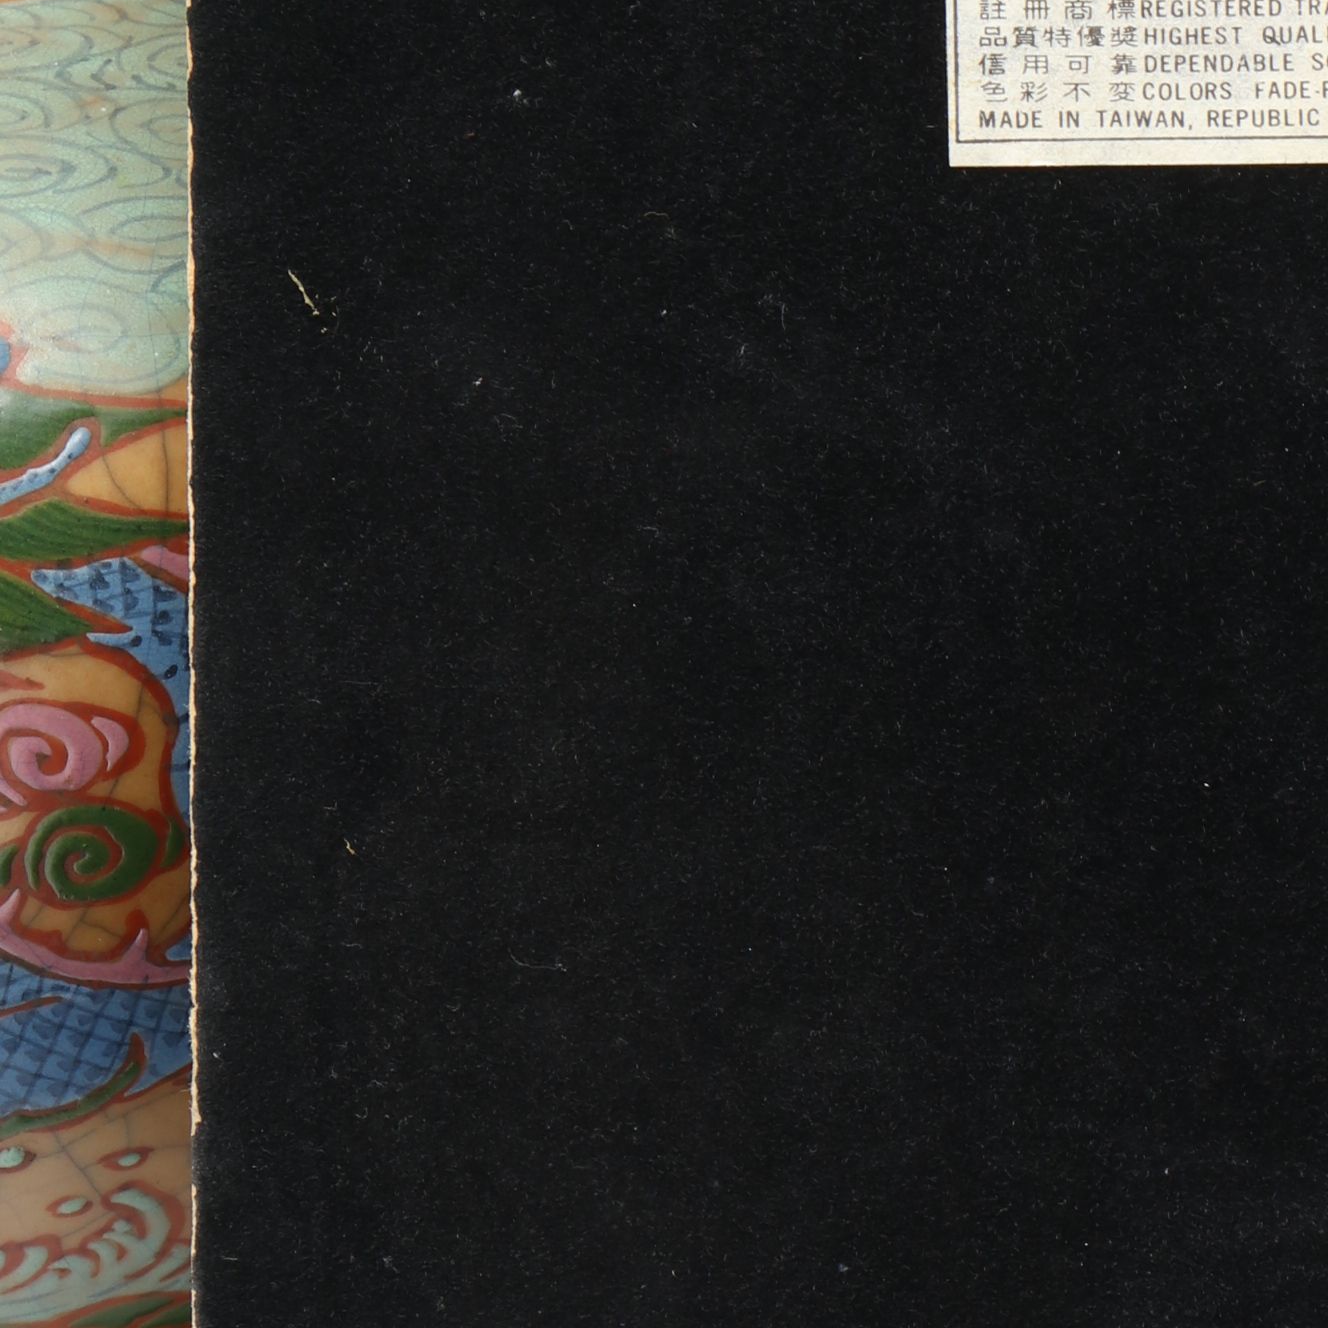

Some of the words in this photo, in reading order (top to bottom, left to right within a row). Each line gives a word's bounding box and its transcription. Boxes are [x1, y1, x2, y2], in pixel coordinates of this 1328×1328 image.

[1144, 26, 1242, 45] HIGHEST
[979, 53, 1137, 75] 信用可靠
[1144, 52, 1294, 73] DEPENDABLE
[1142, 81, 1232, 101] COLORS
[979, 110, 1043, 129] MADE
[1058, 110, 1080, 128] IN
[1096, 109, 1193, 131] TAIWAN,
[1207, 108, 1320, 128] REPUBLIC
